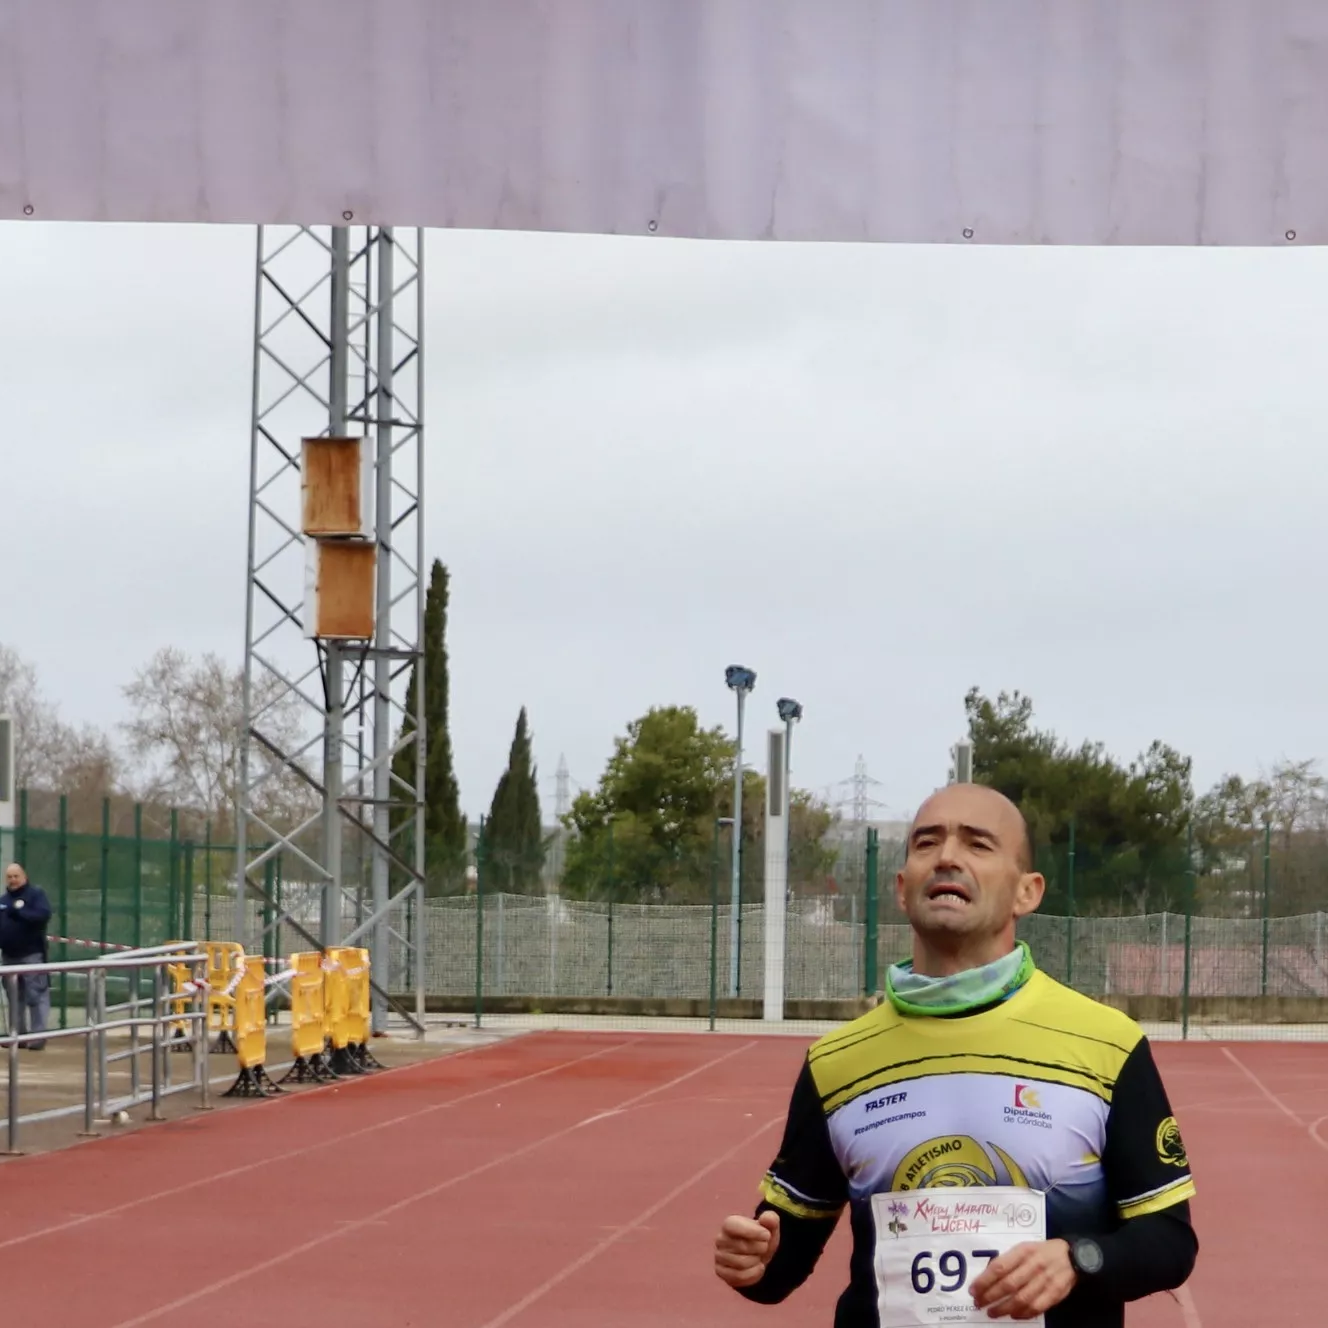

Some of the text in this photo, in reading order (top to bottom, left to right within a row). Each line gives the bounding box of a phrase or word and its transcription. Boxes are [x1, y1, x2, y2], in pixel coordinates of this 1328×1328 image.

[865, 1091, 908, 1113] FASTER
[1003, 1106, 1053, 1121] Diputación
[1003, 1115, 1053, 1130] de Córdoba
[854, 1110, 927, 1137] #teamperezcampos
[906, 1139, 963, 1182] ATLETISMO
[931, 1218, 986, 1233] LUCENA
